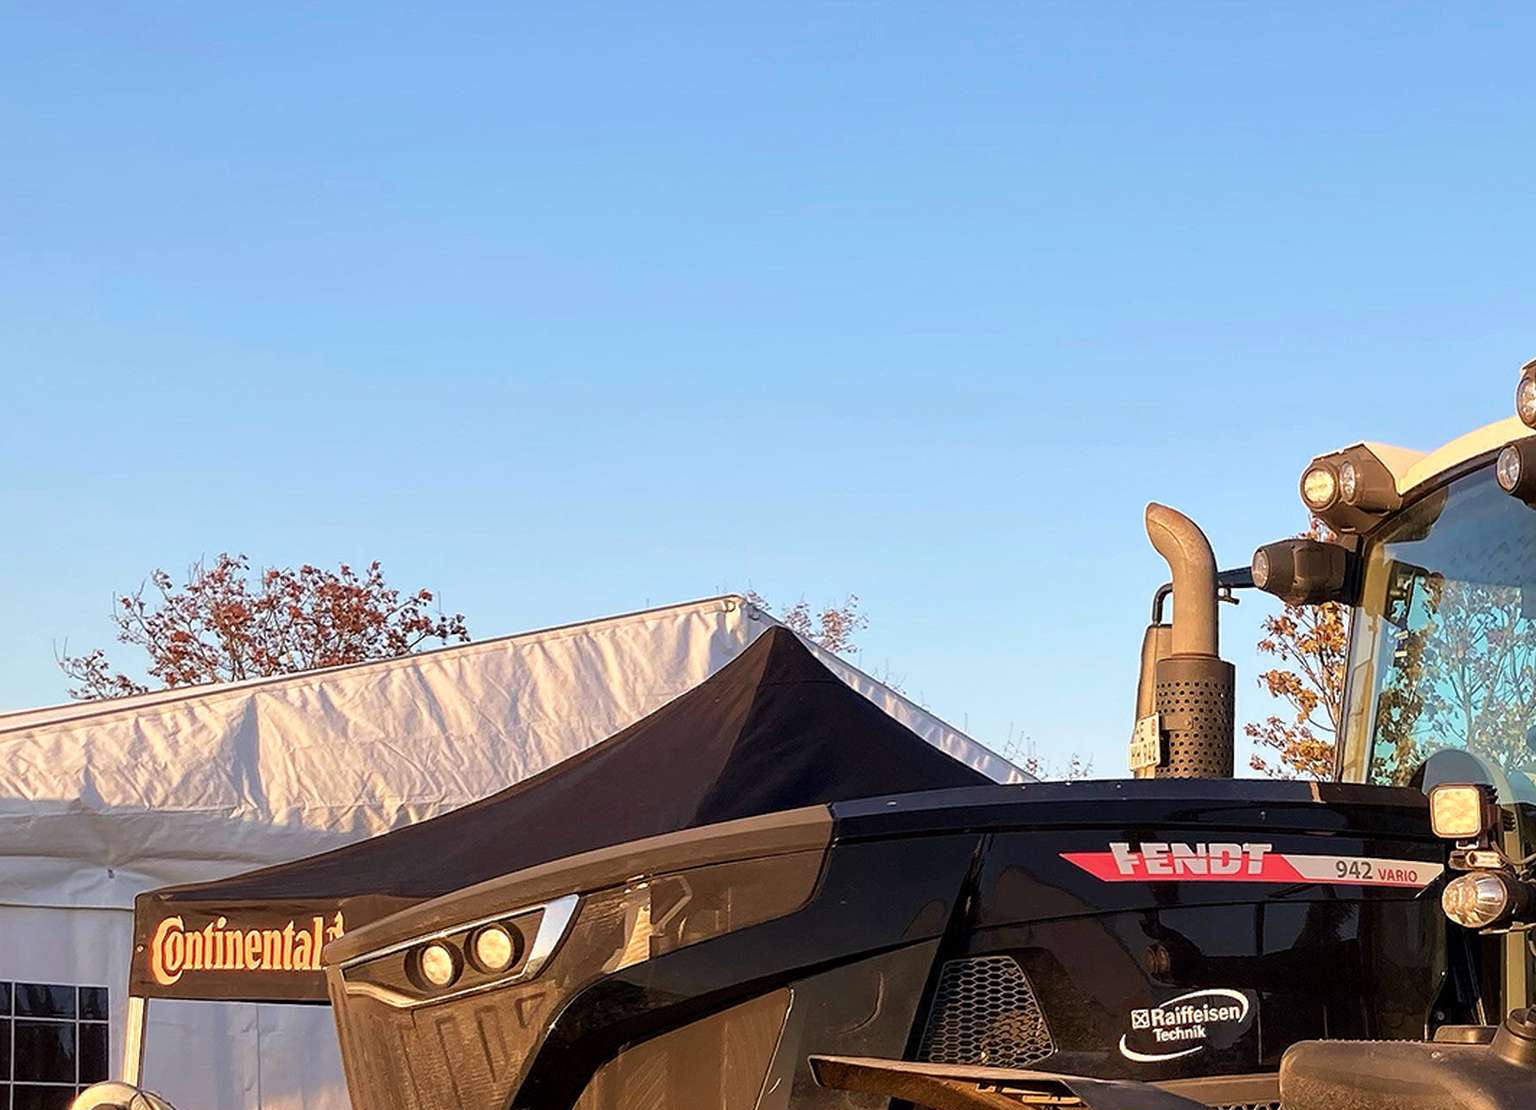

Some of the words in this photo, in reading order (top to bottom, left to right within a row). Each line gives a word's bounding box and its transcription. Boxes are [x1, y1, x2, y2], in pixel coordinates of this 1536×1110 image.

[1109, 842, 1272, 875] FENDT
[1335, 860, 1373, 880] 942
[1377, 868, 1418, 883] VARIO
[152, 915, 323, 986] Continental
[1151, 1003, 1241, 1028] Raiffeisen
[1152, 1025, 1207, 1043] Technik
